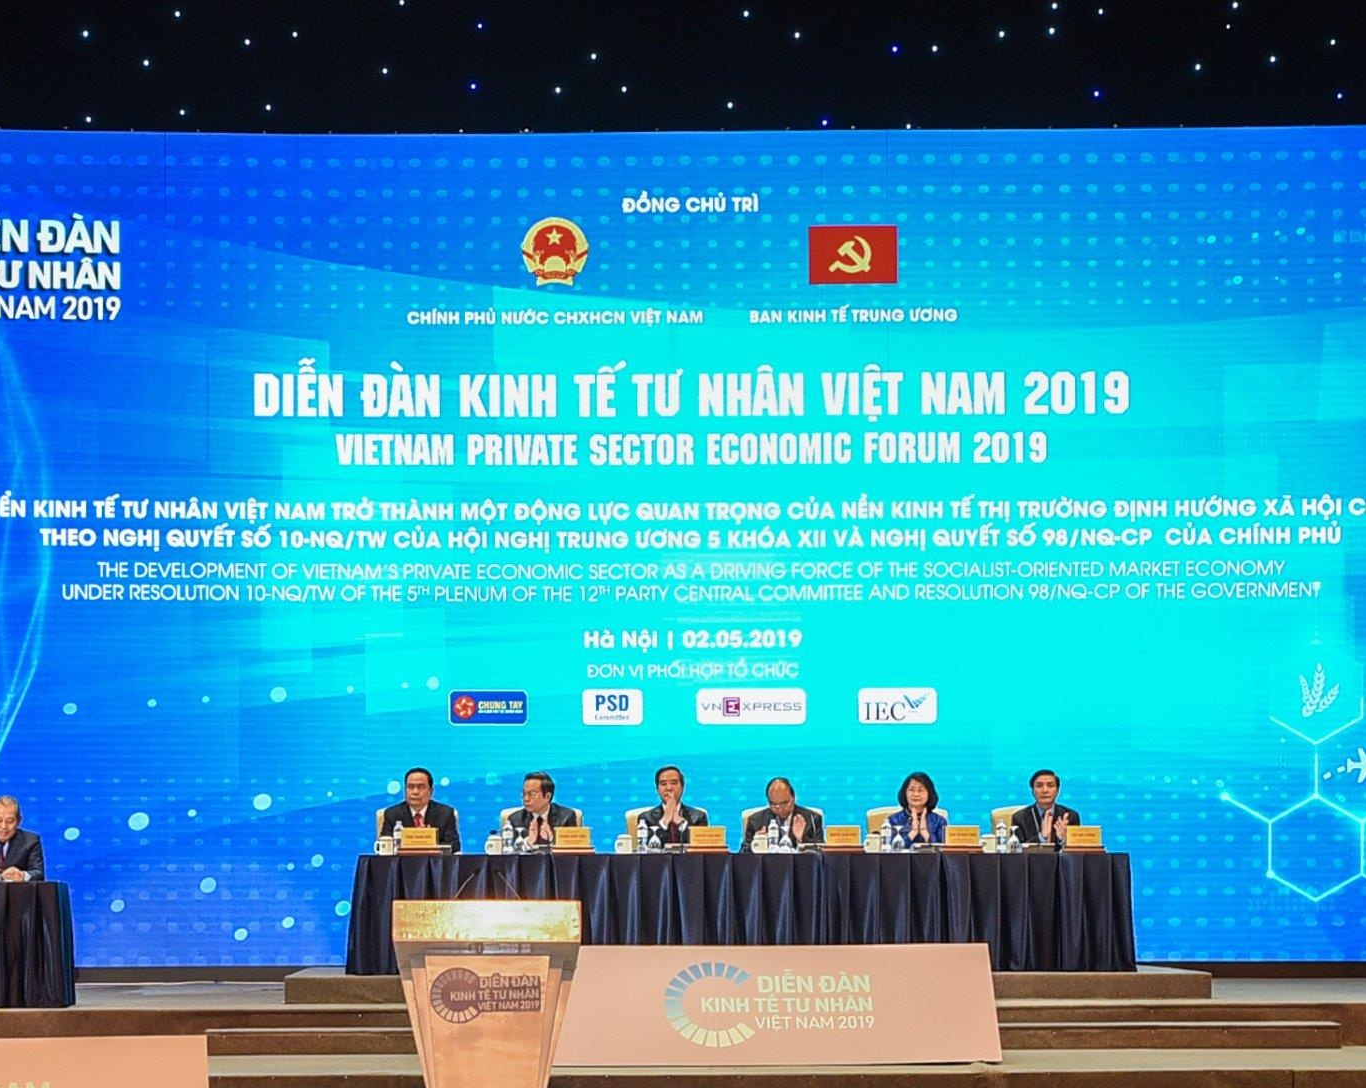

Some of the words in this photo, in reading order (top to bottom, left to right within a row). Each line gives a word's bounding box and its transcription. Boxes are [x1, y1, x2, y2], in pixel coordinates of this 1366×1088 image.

[622, 191, 680, 212] ĐỒNG
[686, 193, 726, 212] CHỦ
[732, 194, 758, 211] TRÌ
[36, 212, 120, 254] ĐÀN
[28, 256, 121, 290] NHÂN
[63, 296, 121, 321] 2019
[407, 309, 459, 324] CHÍNH
[465, 308, 495, 324] PHỦ
[502, 309, 548, 324] NƯỚC
[554, 311, 625, 324] CHXHCN
[631, 308, 661, 325] VIỆT
[667, 311, 702, 322] NAM
[750, 311, 782, 323] BAN
[788, 310, 826, 322] KINH
[832, 305, 848, 322] TẾ
[852, 309, 904, 322] TRUNG
[910, 308, 957, 321] ƯƠNG
[254, 358, 343, 416] DIỄN
[361, 361, 440, 417] ĐÀN
[460, 375, 556, 417] KINH
[574, 360, 627, 418] TẾ
[631, 368, 684, 418] TƯ
[699, 365, 804, 416] NHÂN
[822, 364, 903, 421] VIỆT
[922, 372, 1005, 414] NAM
[1025, 371, 1130, 415] 2019
[336, 434, 453, 465] VIETNAM
[468, 434, 577, 465] PRIVATE
[590, 434, 693, 465] SECTOR
[708, 433, 851, 465] ECONOMIC
[865, 432, 960, 463] FORUM
[974, 432, 1046, 463] 2019
[34, 501, 86, 518] KINH
[155, 497, 218, 519] NHÂN
[225, 497, 268, 525] VIỆT
[275, 503, 325, 519] NAM
[332, 497, 374, 520] TRỞ
[380, 499, 453, 520] THÀNH
[461, 499, 507, 524] MỘT
[514, 499, 581, 524] ĐỘNG
[589, 502, 629, 524] LỰC
[636, 503, 699, 520] QUAN
[706, 502, 780, 524] TRỌNG
[842, 494, 883, 518] NỀN
[892, 502, 943, 518] KINH
[1018, 497, 1106, 521] TRƯỜNG
[1114, 501, 1167, 521] ĐỊNH
[1175, 496, 1256, 521] HƯỚNG
[40, 528, 96, 546] THEO
[104, 529, 159, 551] NGHỊ
[167, 523, 235, 547] QUYẾT
[280, 531, 386, 549] 10-NQ/TW
[495, 526, 549, 551] NGHỊ
[557, 526, 628, 548] TRUNG
[636, 530, 701, 548] ƯƠNG
[728, 525, 790, 548] KHÓA
[871, 529, 925, 550] NGHỊ
[933, 523, 1000, 546] QUYẾT
[1043, 524, 1152, 547] 98/NQ-CP
[1220, 523, 1290, 544] CHÍNH
[1299, 521, 1341, 543] PHỦ
[135, 563, 267, 579] DEVELOPMENT
[302, 562, 399, 580] VIETNAM'S
[403, 564, 471, 580] PRIVATE
[478, 564, 582, 579] ECONOMIC
[590, 564, 658, 579] SECTOR
[711, 563, 786, 579] DRIVING
[792, 562, 850, 578] FORCE
[925, 561, 1104, 578] SOCIALIST-ORIENTED
[1110, 561, 1179, 576] MARKET
[1186, 561, 1284, 576] ECONOMY
[62, 585, 126, 601] UNDER
[129, 585, 242, 601] RESOLUTION
[248, 585, 335, 602] 10-NQ/TW
[435, 586, 506, 601] PLENUM
[616, 586, 667, 600] PARTY
[675, 586, 753, 601] CENTRAL
[759, 585, 861, 601] COMMITTEE
[916, 584, 1023, 599] RESOLUTION
[1029, 583, 1122, 601] 98/NQ-CP
[1191, 582, 1320, 598] GOVERNMENT
[584, 630, 614, 648] Hà
[622, 630, 657, 652] Nội
[683, 630, 802, 648] 02.05.2019
[478, 701, 507, 710] CHUNG
[508, 701, 523, 710] TAY
[595, 694, 629, 712] PSD
[864, 701, 906, 721] IEC
[757, 968, 814, 994] DIỄN
[818, 970, 870, 993] ĐÀN
[700, 996, 750, 1014] KINH
[813, 995, 874, 1013] NHÂN
[755, 1012, 791, 1032] VIỆT
[795, 1016, 834, 1030] NAM
[838, 1015, 875, 1030] 2019
